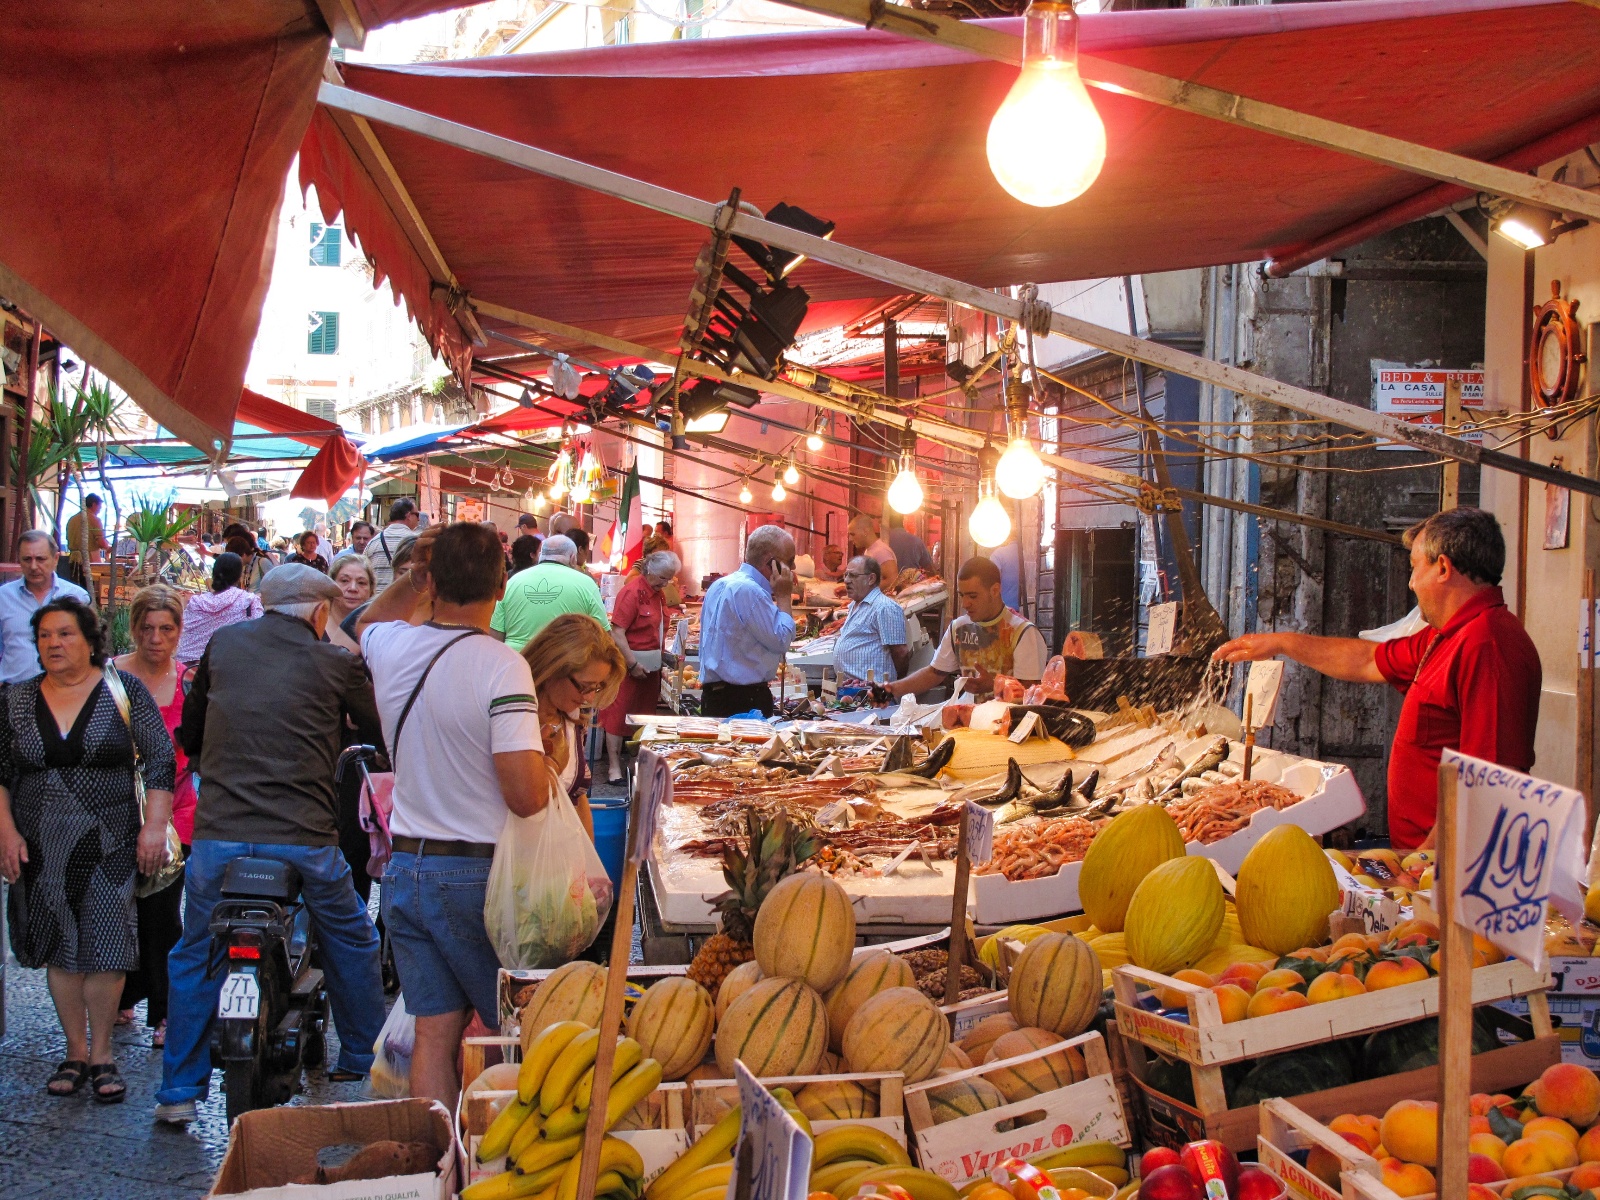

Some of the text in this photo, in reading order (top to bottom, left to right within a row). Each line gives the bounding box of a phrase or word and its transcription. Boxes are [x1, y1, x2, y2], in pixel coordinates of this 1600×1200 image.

[1382, 373, 1412, 382] BED
[1423, 373, 1433, 382] &
[1423, 415, 1432, 424] &
[238, 872, 275, 881] PIAGGIO
[230, 978, 252, 995] 7T
[222, 996, 256, 1013] JTT
[1132, 1012, 1188, 1045] AGRIBOX
[960, 1123, 1074, 1178] VITOLO
[1280, 1160, 1336, 1200] AGRIBO
[385, 1189, 420, 1200] QUALITÀ
